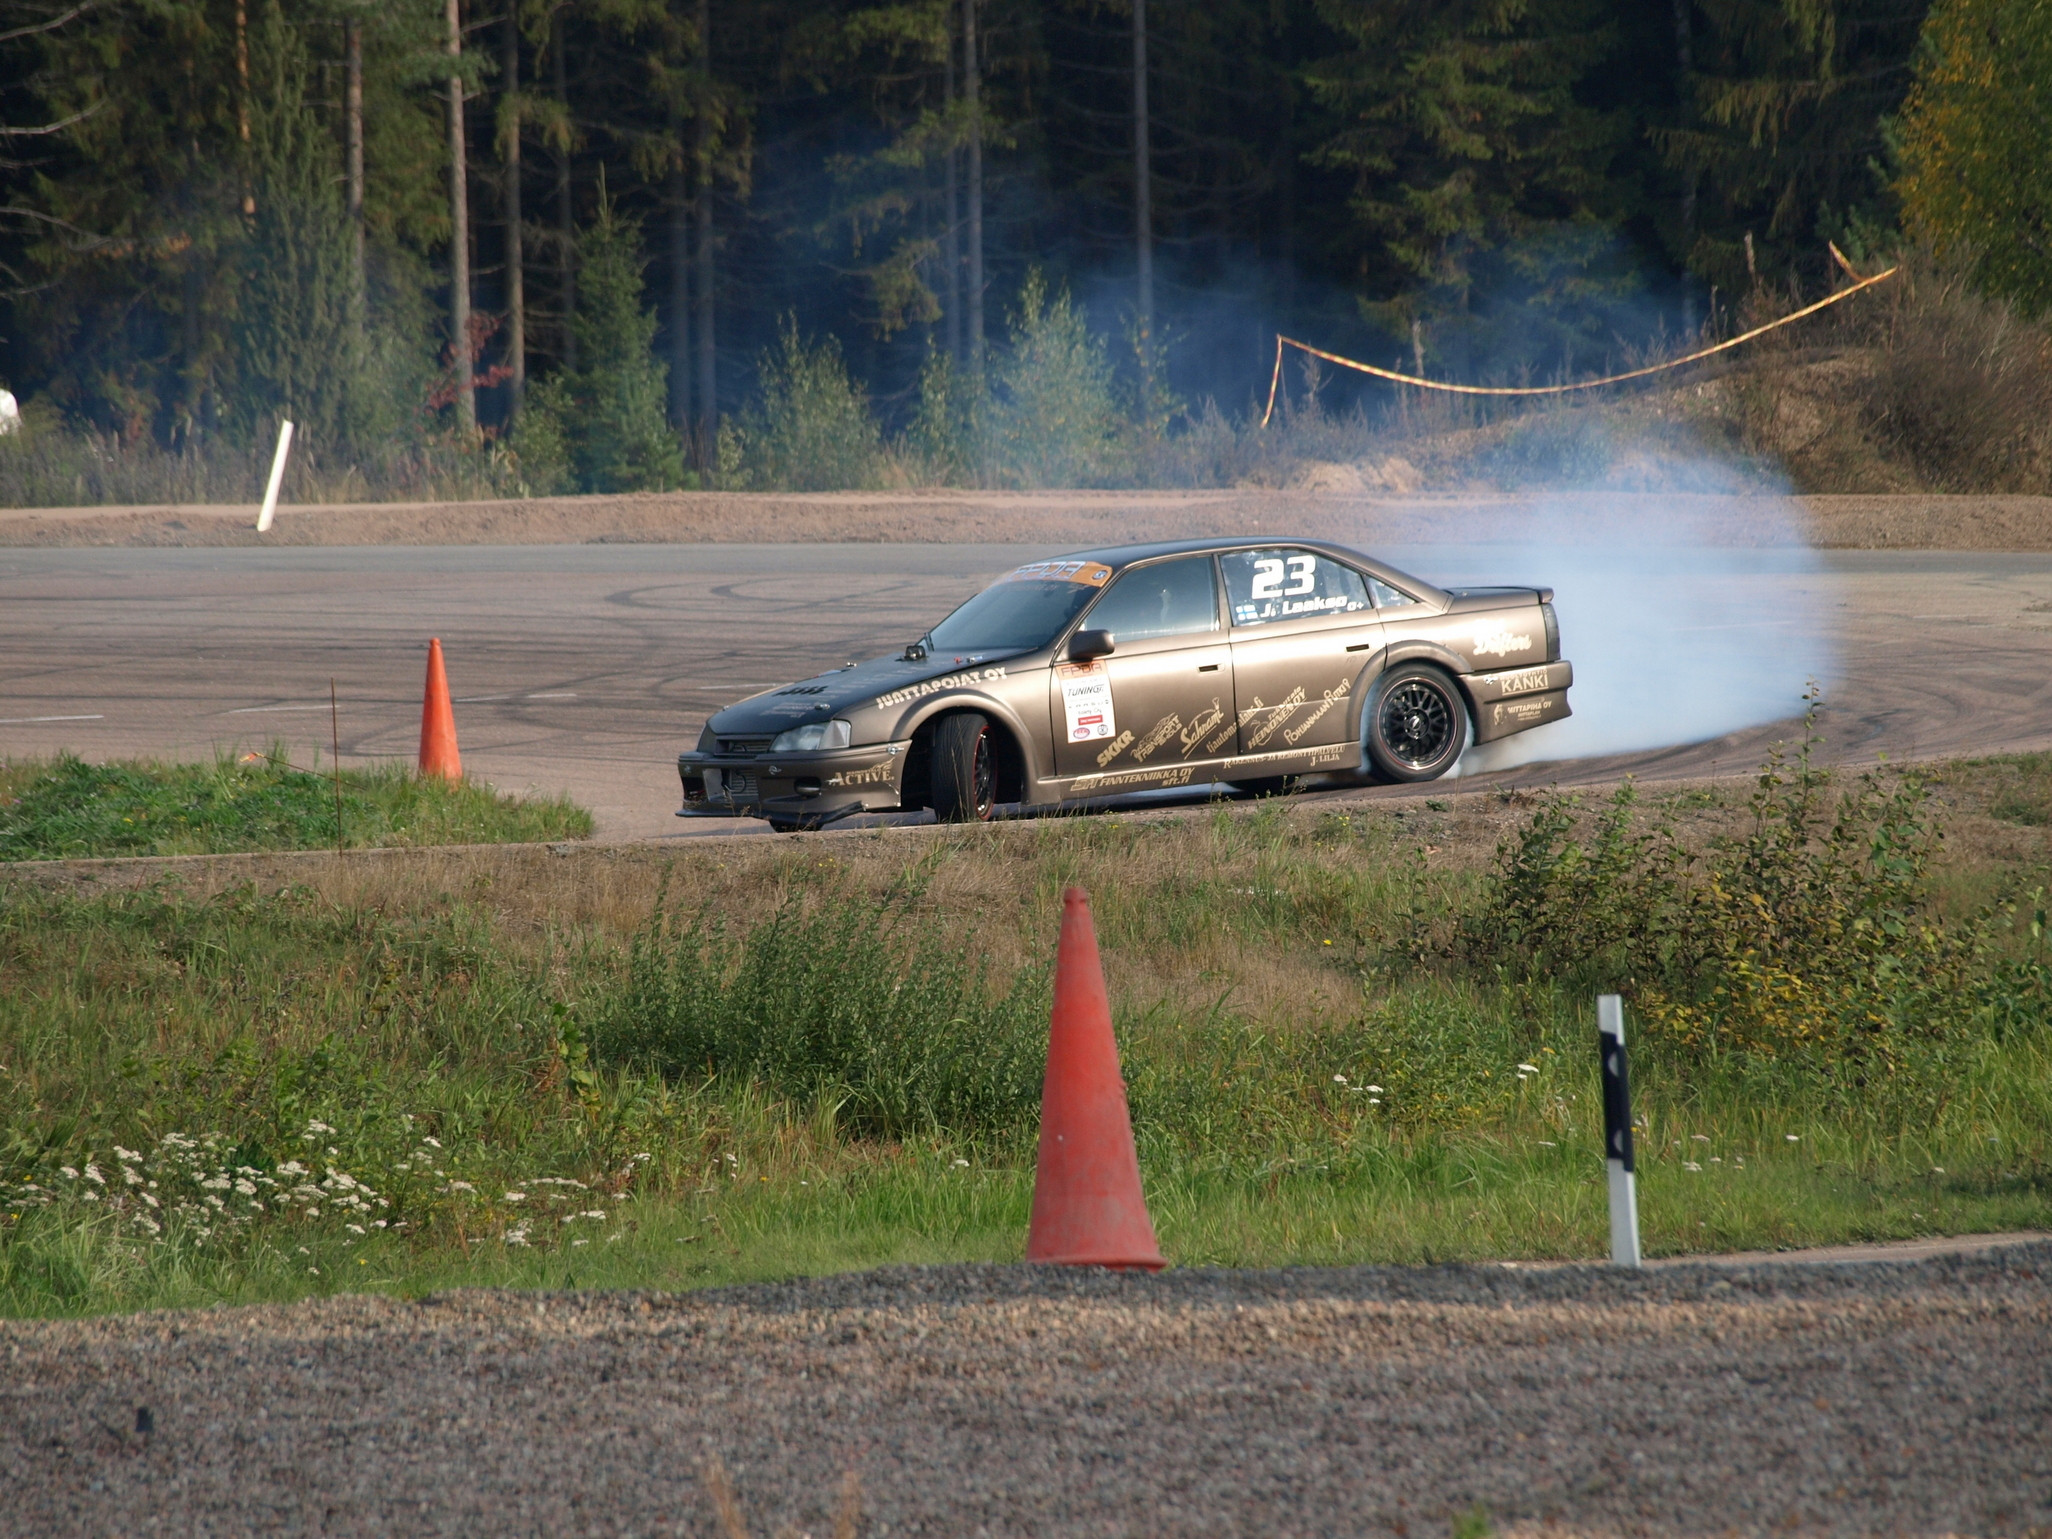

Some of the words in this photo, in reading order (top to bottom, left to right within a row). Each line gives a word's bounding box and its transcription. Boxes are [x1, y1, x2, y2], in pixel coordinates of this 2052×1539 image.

[1252, 555, 1316, 599] 23
[1260, 602, 1277, 618] J.
[984, 666, 1008, 682] OY
[1501, 674, 1549, 693] KANKI
[1097, 729, 1136, 768] SKKR
[1180, 767, 1196, 777] OY
